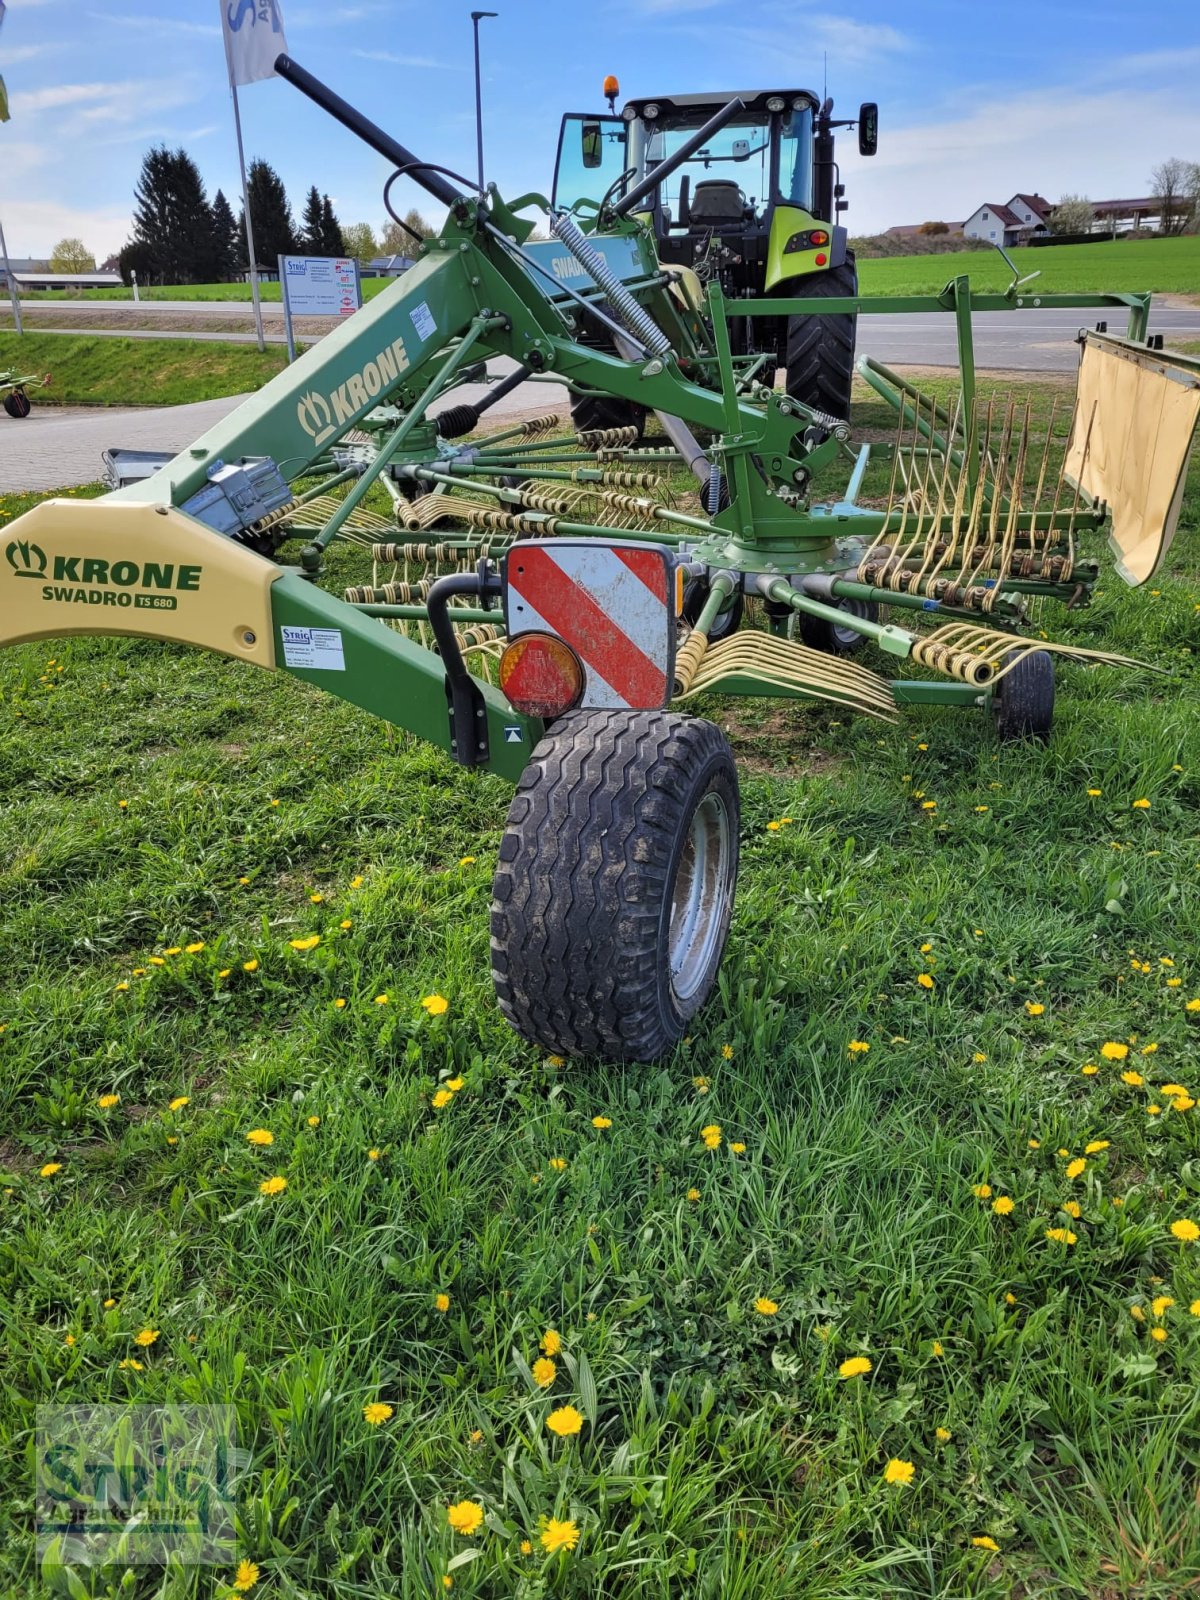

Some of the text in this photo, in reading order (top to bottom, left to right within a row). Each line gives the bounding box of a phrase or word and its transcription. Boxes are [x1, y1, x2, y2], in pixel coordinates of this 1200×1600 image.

[330, 336, 410, 426] KRONE
[53, 555, 203, 591] KRONE
[42, 586, 173, 608] SWADRO TS 680
